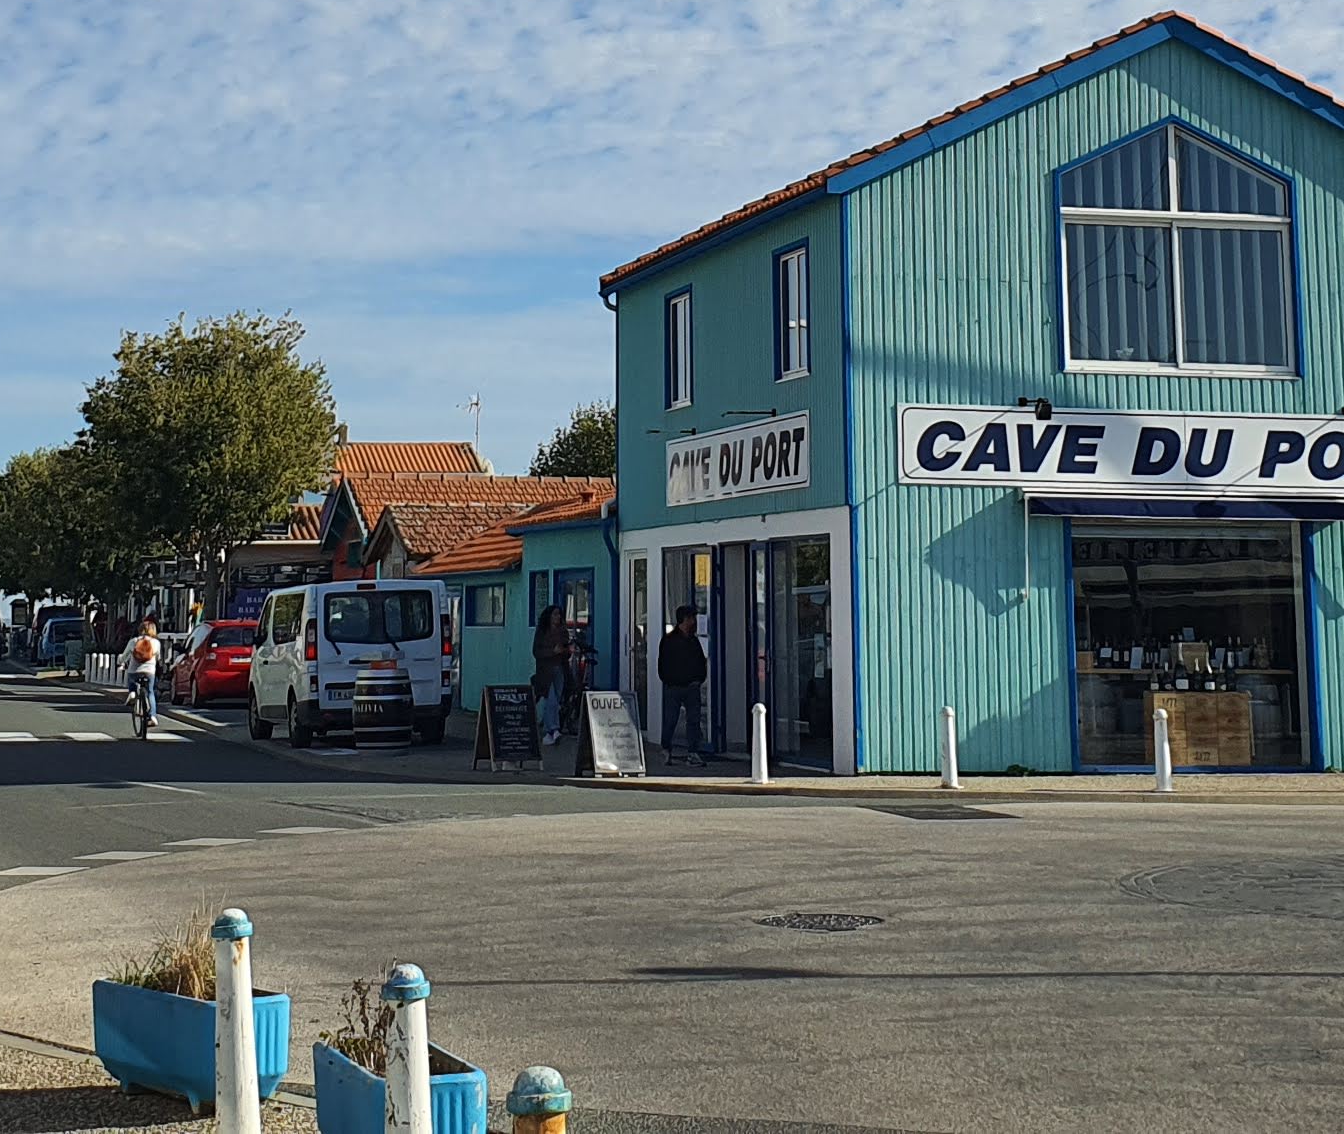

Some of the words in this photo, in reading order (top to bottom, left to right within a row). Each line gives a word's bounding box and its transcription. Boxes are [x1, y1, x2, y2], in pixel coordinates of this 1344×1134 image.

[719, 439, 745, 488] DU
[749, 426, 805, 483] PORT
[916, 420, 1106, 474] CAVE
[1131, 426, 1234, 478] DU
